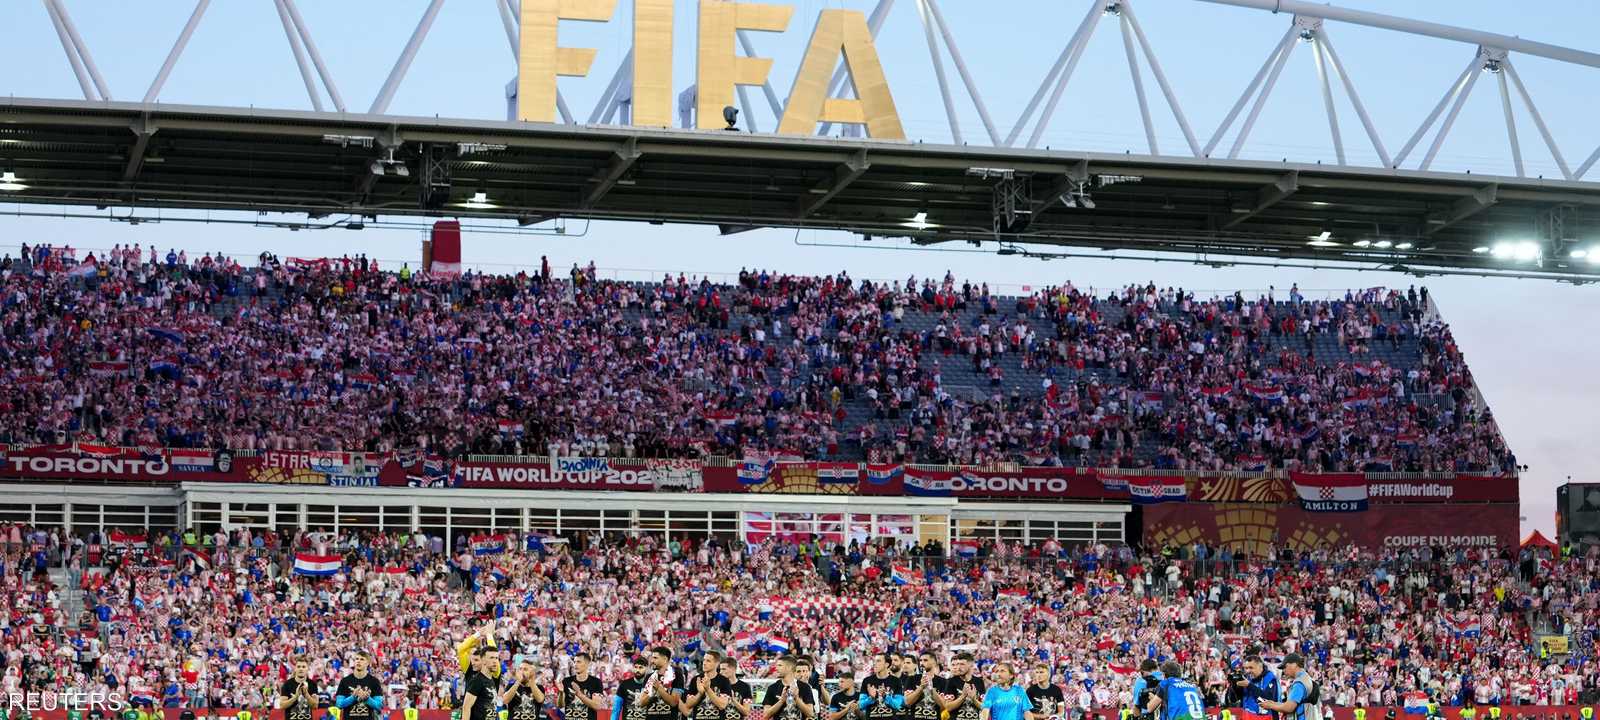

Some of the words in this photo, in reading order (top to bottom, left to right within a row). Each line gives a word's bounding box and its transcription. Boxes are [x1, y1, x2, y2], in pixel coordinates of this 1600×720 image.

[518, 0, 906, 139] FIFA
[9, 457, 169, 475] TORONTO
[459, 467, 496, 482] FIFA
[497, 468, 562, 483] WORLD
[567, 471, 603, 484] CUP
[605, 470, 653, 485] 202
[950, 477, 1068, 492] ORONTO
[1369, 483, 1453, 498] #FIFAWorldCup
[1303, 501, 1358, 510] AMILTON
[1384, 535, 1427, 546] COUPE
[1450, 535, 1497, 546] MONDE
